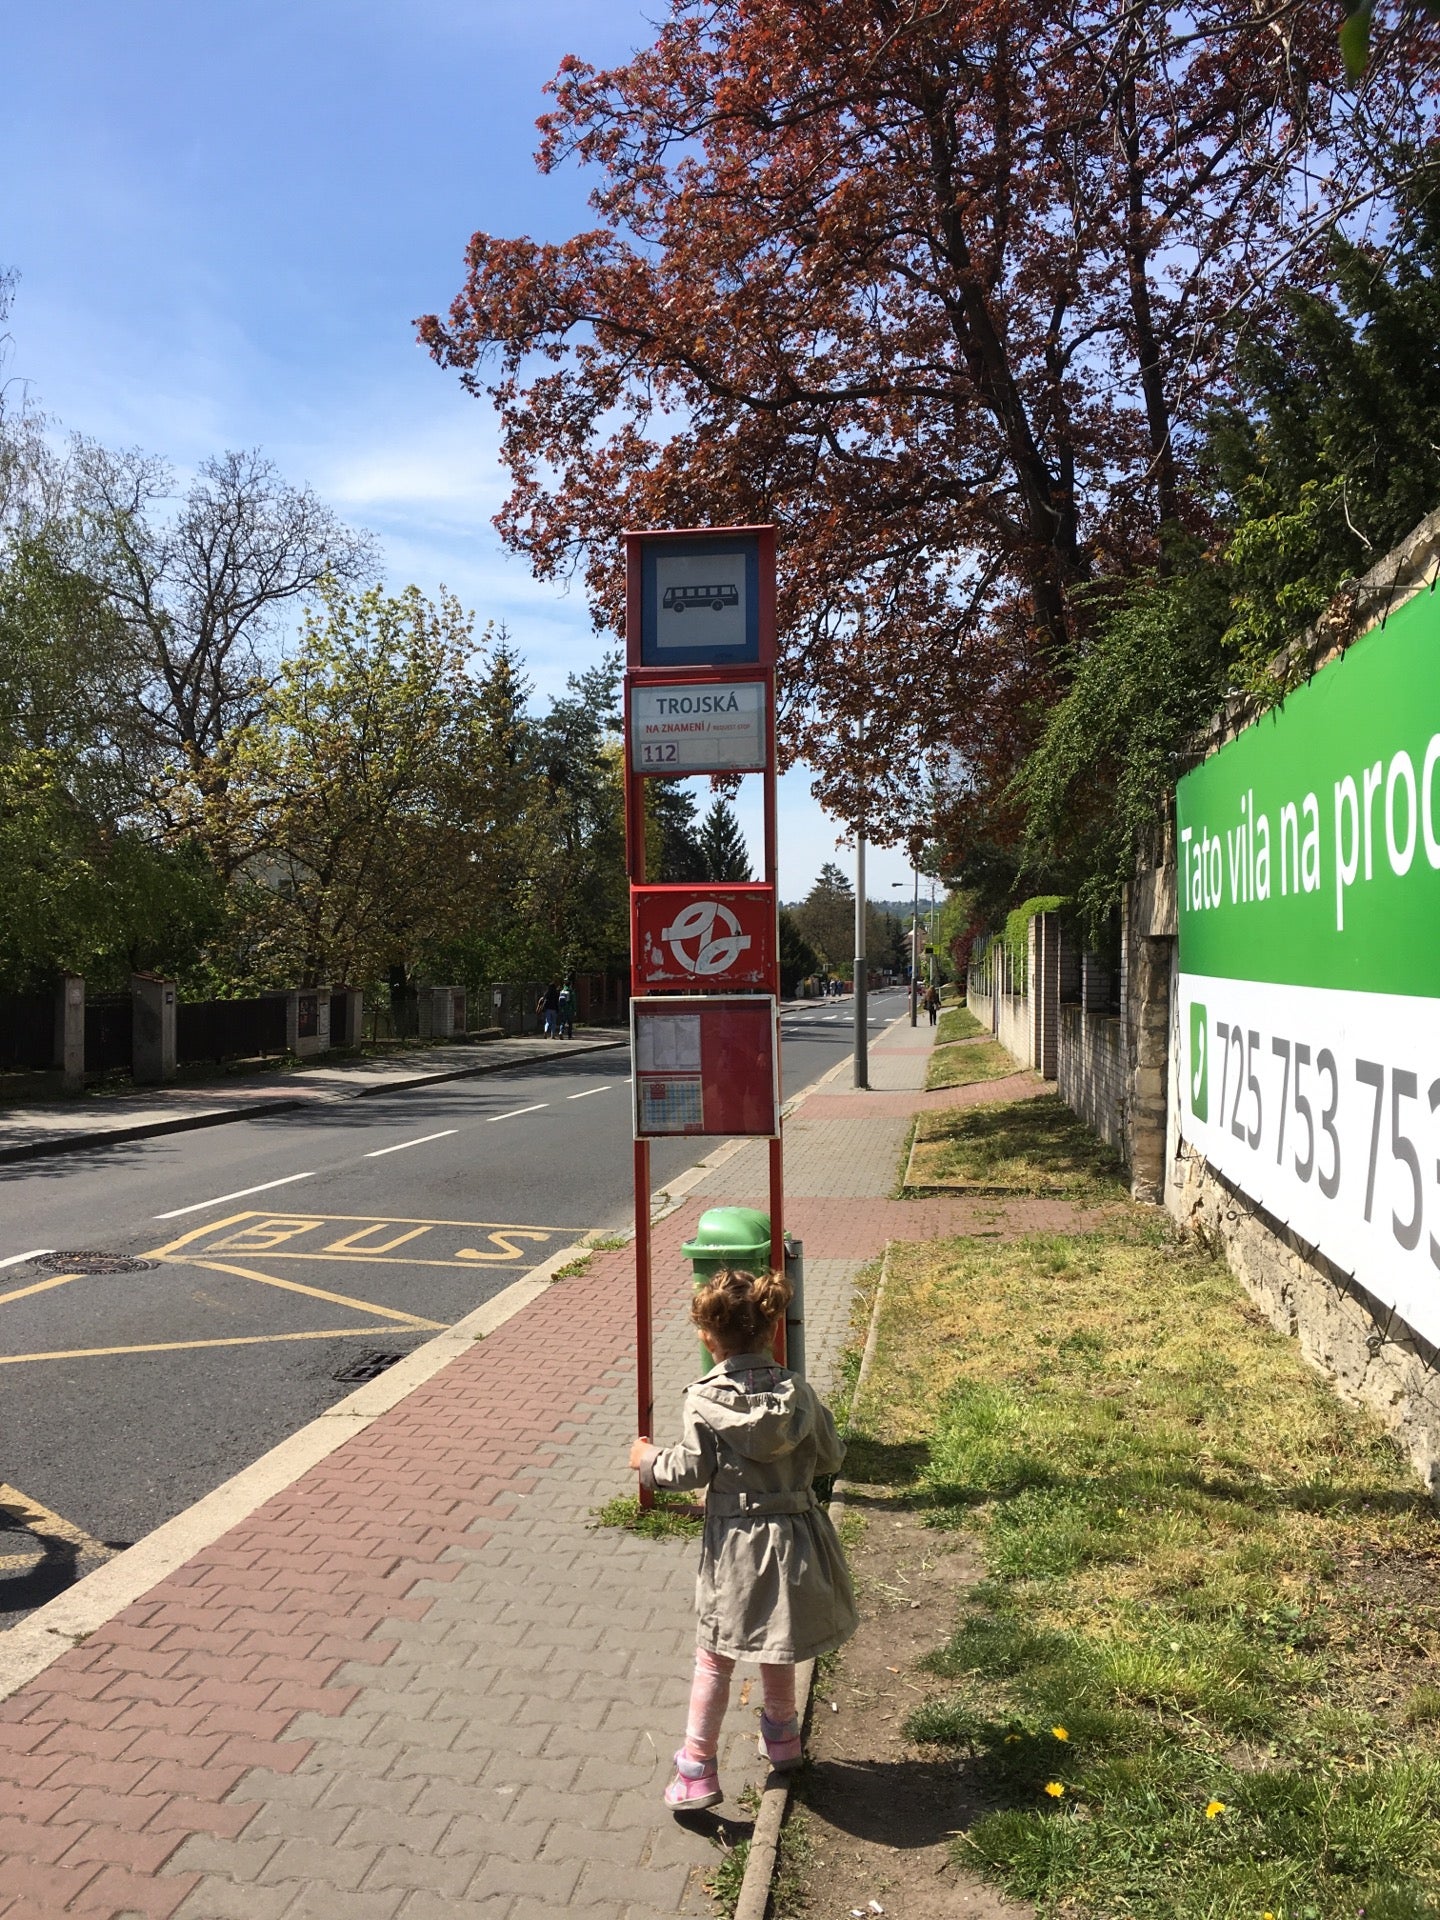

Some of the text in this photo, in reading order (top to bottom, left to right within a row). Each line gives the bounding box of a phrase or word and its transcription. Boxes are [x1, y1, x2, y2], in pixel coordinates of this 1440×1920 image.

[656, 691, 739, 714] TROJSKÁ
[646, 724, 659, 734] NA
[662, 721, 705, 733] ZNAMENÍ
[643, 744, 677, 763] 112
[1181, 825, 1223, 912] Tato
[1227, 788, 1271, 905] vila
[1280, 792, 1321, 896] na
[1216, 1021, 1263, 1151] 725
[1272, 1036, 1341, 1200] 753
[204, 1219, 550, 1260] BUS
